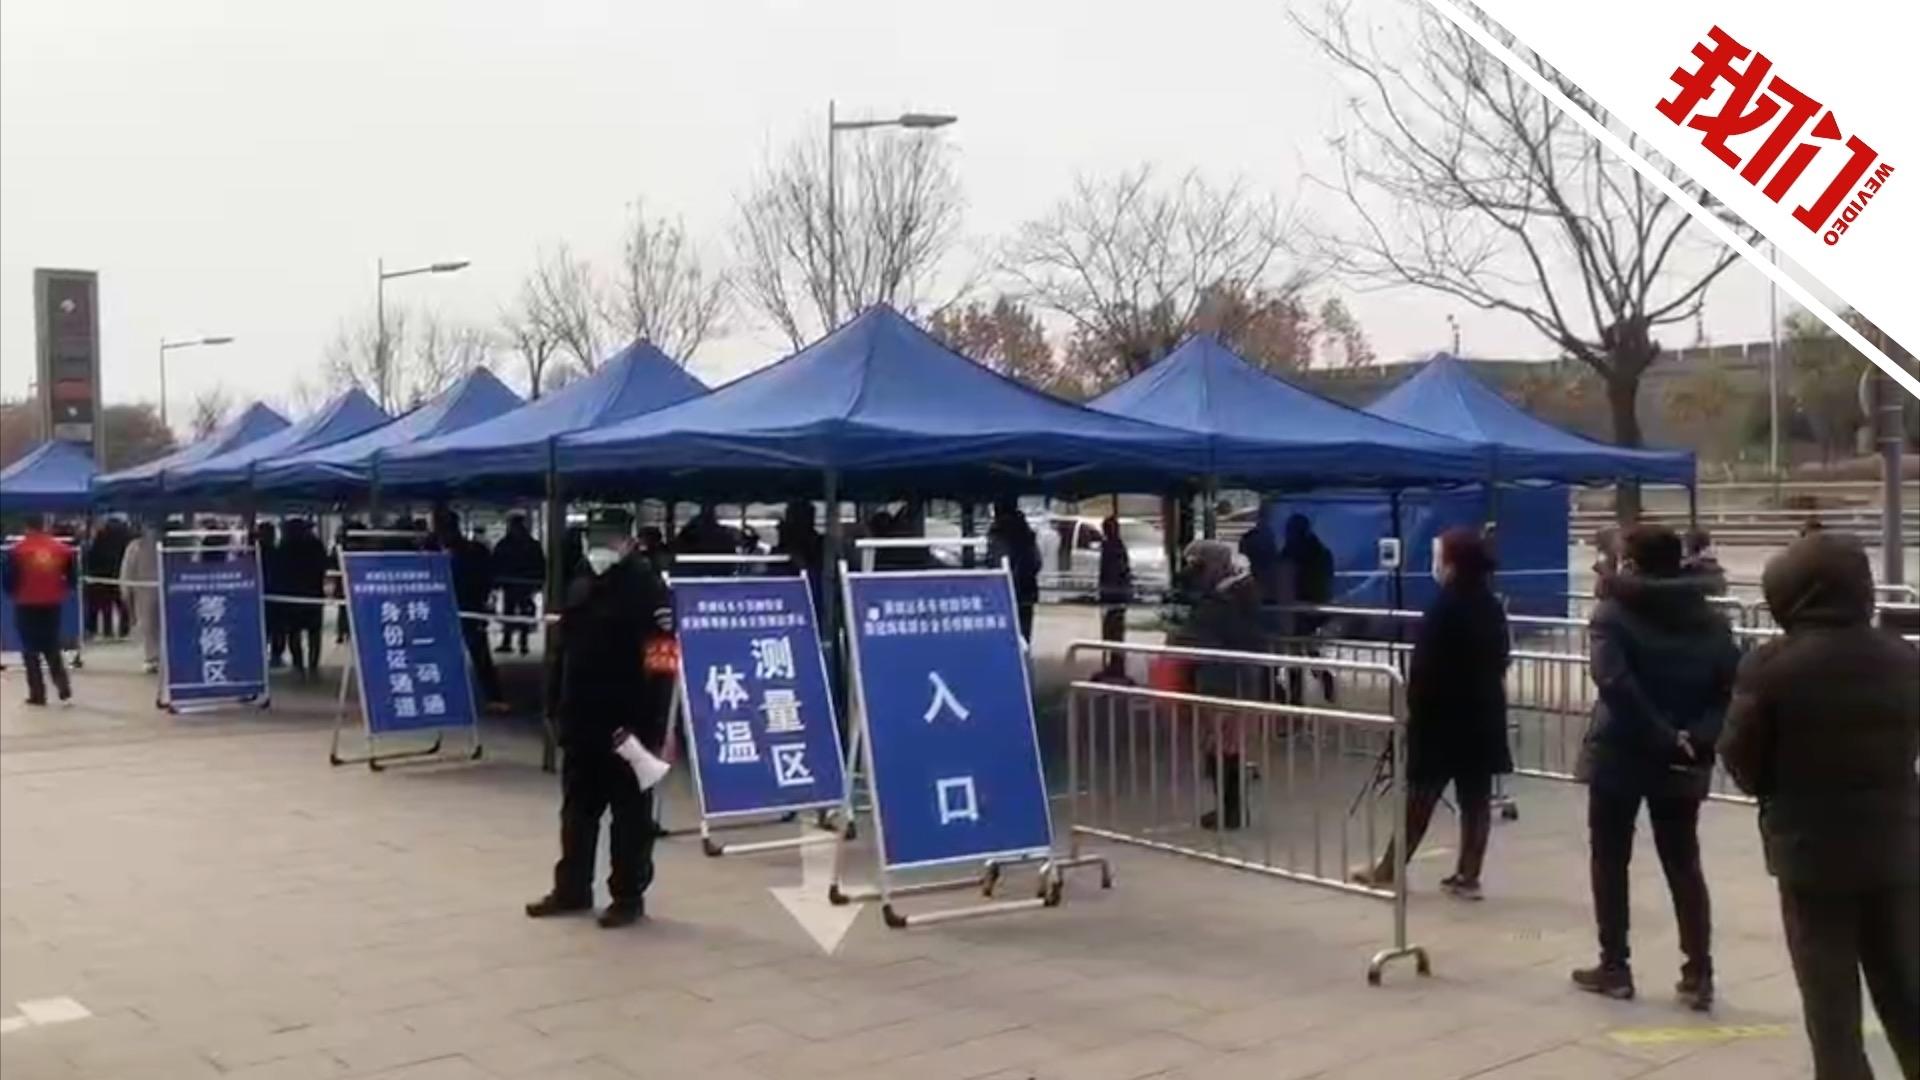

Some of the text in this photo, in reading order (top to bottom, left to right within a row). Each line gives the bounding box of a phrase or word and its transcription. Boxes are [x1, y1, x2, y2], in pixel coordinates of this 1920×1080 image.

[705, 664, 760, 763] 体温
[751, 635, 815, 787] 测量区
[922, 671, 979, 825] 入口
